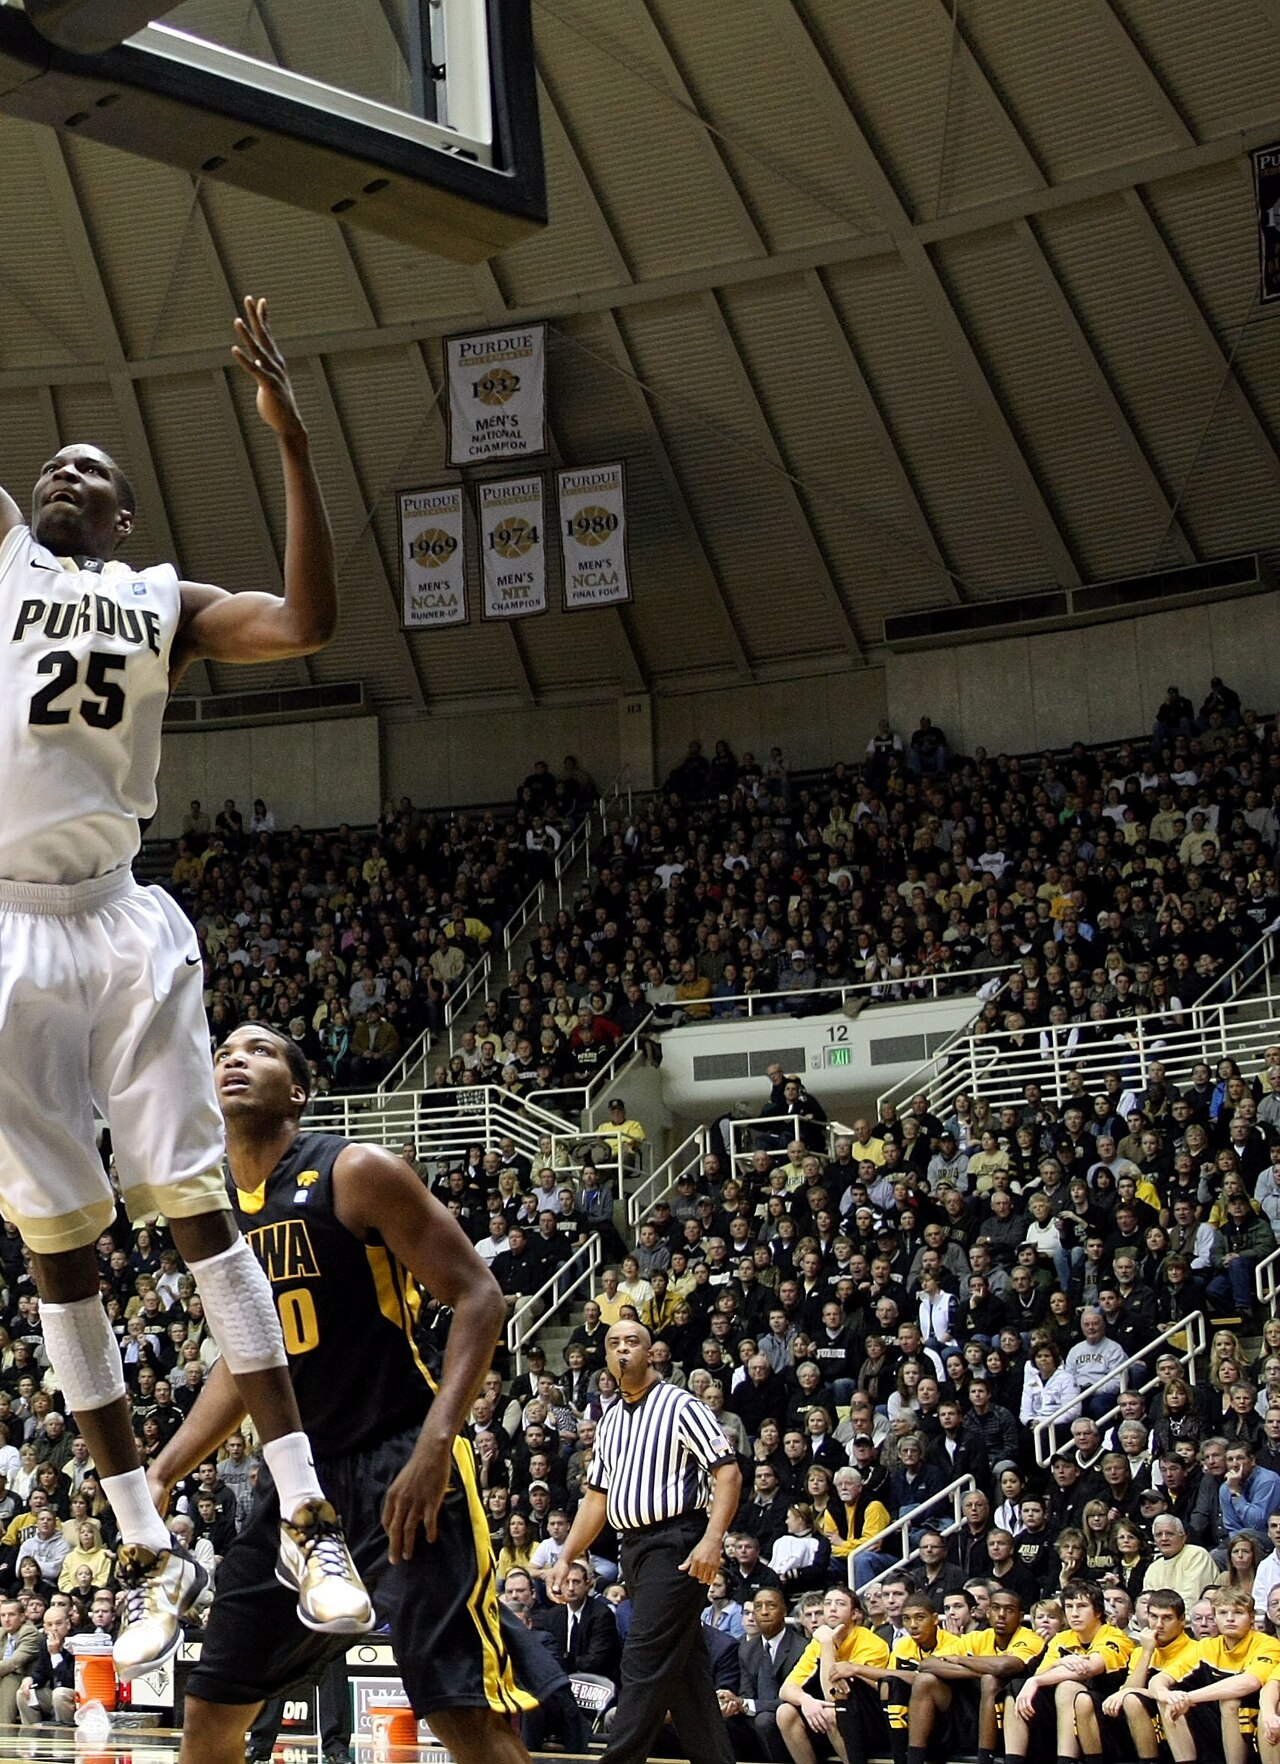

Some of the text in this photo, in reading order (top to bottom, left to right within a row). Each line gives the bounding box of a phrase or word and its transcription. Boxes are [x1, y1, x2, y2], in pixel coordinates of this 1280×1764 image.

[459, 335, 533, 357] PURDUE
[472, 376, 521, 398] 1932
[476, 415, 518, 430] MEN'S
[471, 430, 522, 443] NATIONAL
[468, 441, 527, 456] CHAMPION
[561, 472, 620, 488] PURDUE
[483, 483, 540, 500] PURDUE
[403, 495, 460, 511] PURDUE
[566, 514, 619, 537] 1980
[488, 527, 540, 550] 1974
[409, 536, 458, 559] 1969
[578, 560, 612, 571] MEN'S
[418, 581, 451, 592] MEN'S
[497, 573, 534, 586] MEN'S
[572, 572, 620, 589] NCAA
[501, 586, 531, 600] NIT
[572, 586, 621, 599] FINAL FOUR
[410, 594, 459, 610] NCAA
[491, 600, 541, 611] CHAMPION
[411, 608, 458, 620] RUNNER-UP
[10, 592, 161, 658] PURDUE
[28, 650, 127, 730] 25
[826, 1026, 848, 1042] 12
[831, 1048, 851, 1065] EXIT
[244, 1220, 320, 1281] WA
[278, 1288, 320, 1355] 0
[183, 1644, 196, 1659] K
